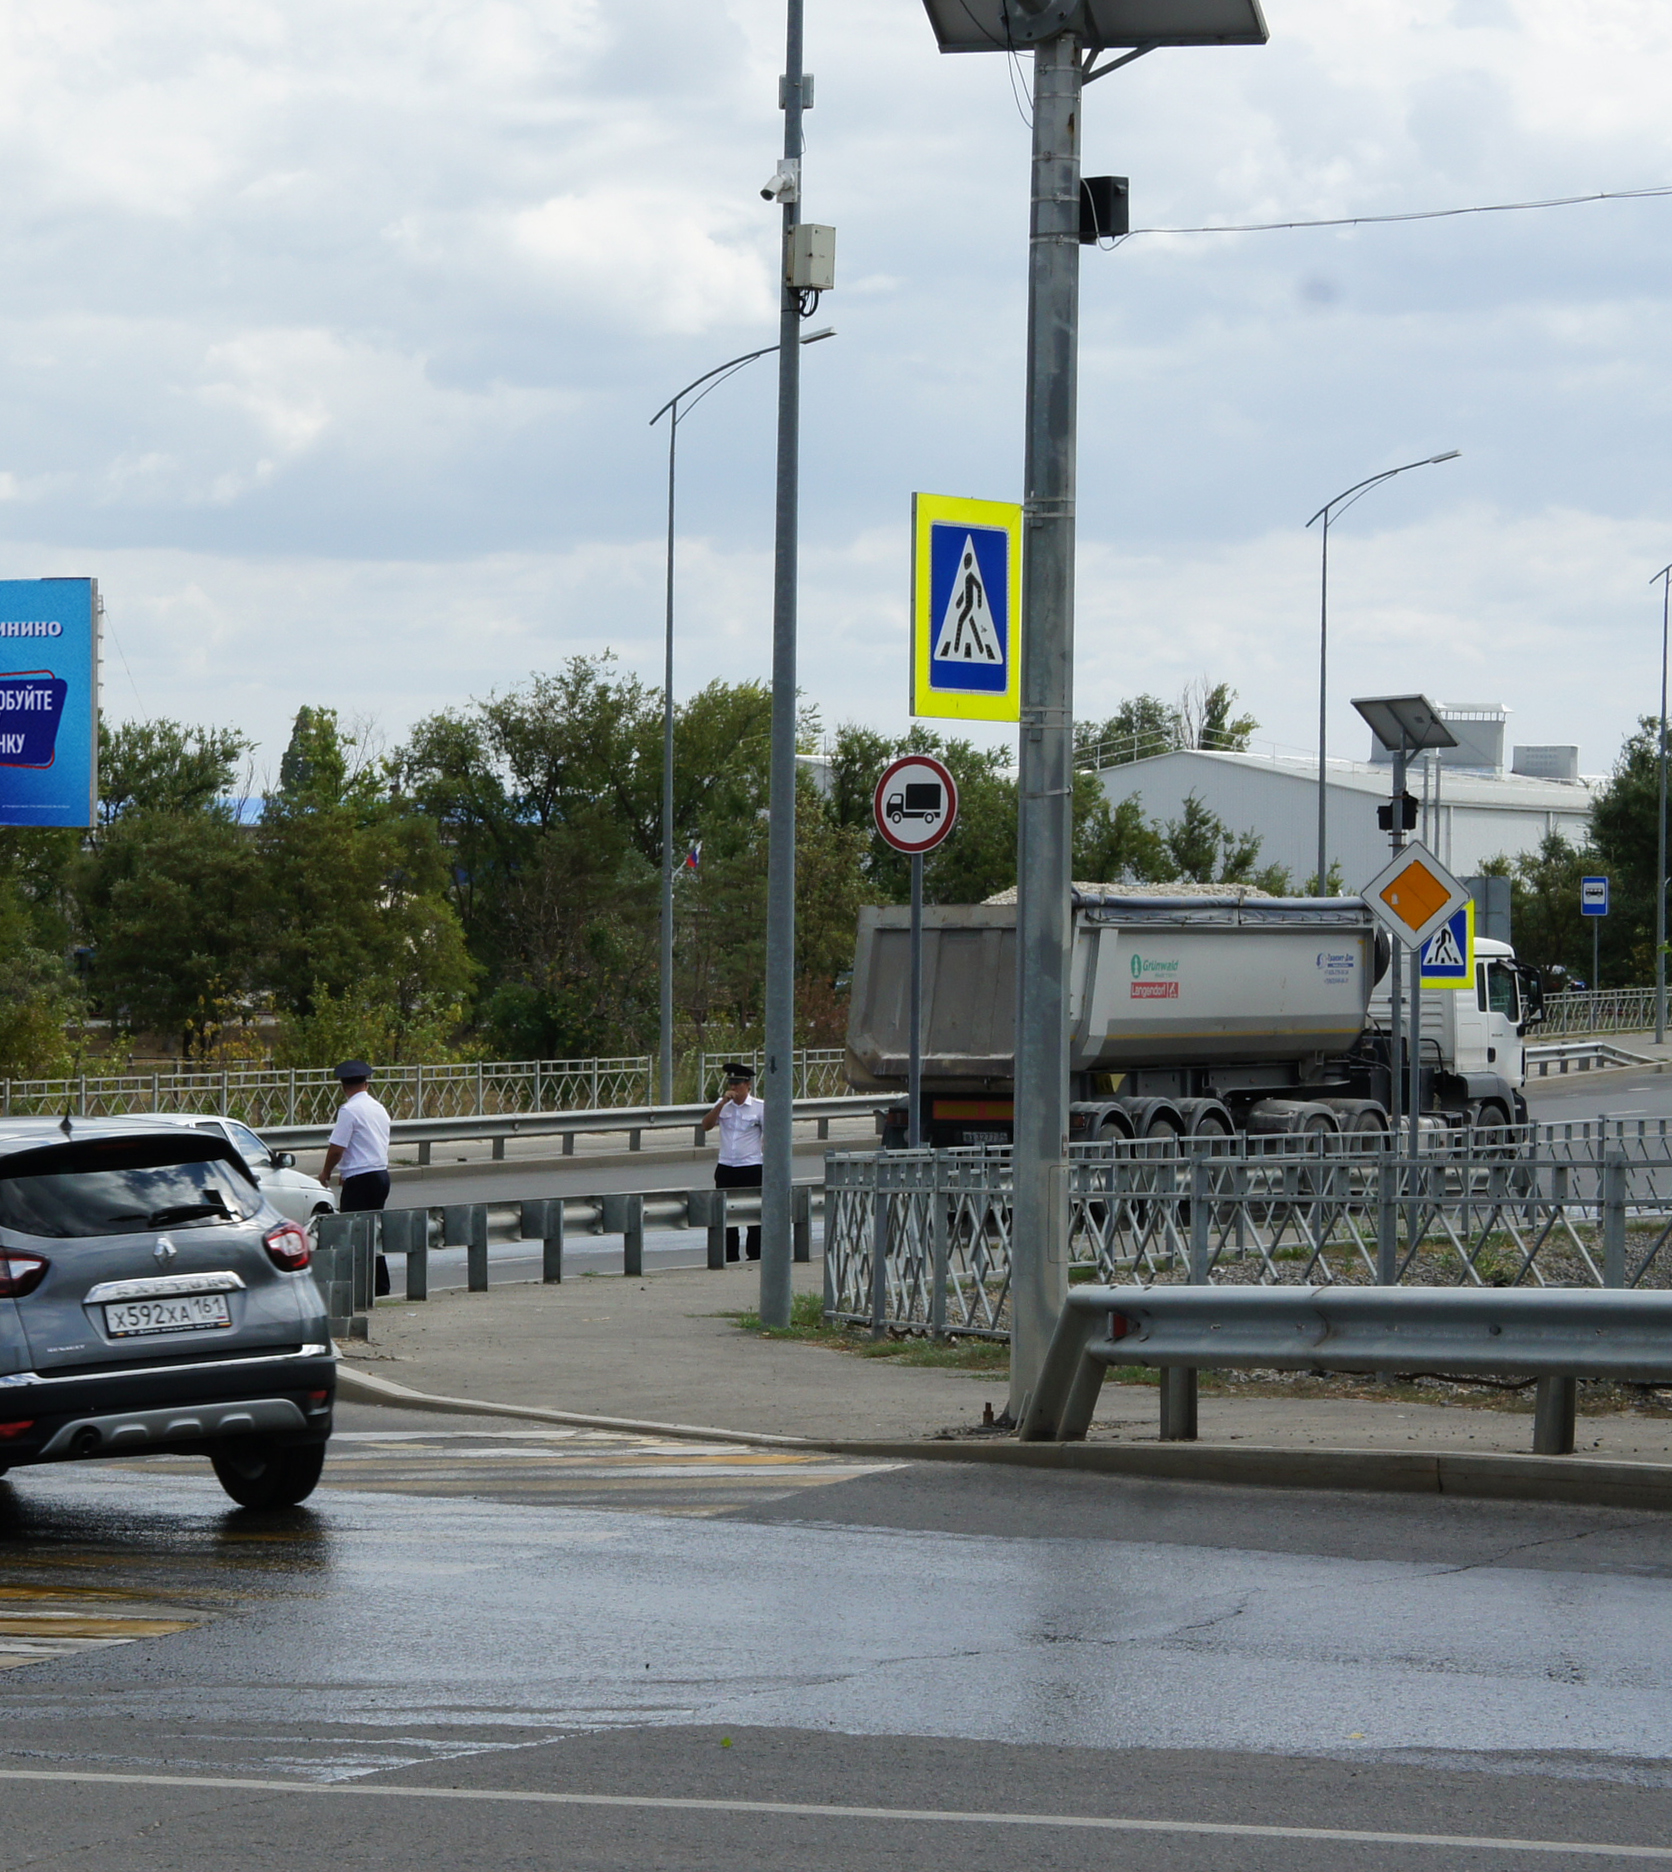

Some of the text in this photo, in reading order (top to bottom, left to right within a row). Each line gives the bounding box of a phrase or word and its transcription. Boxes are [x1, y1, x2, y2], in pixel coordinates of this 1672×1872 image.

[1143, 959, 1179, 971] Grünwald
[1132, 983, 1166, 998] Langendorf
[193, 1296, 222, 1314] 161
